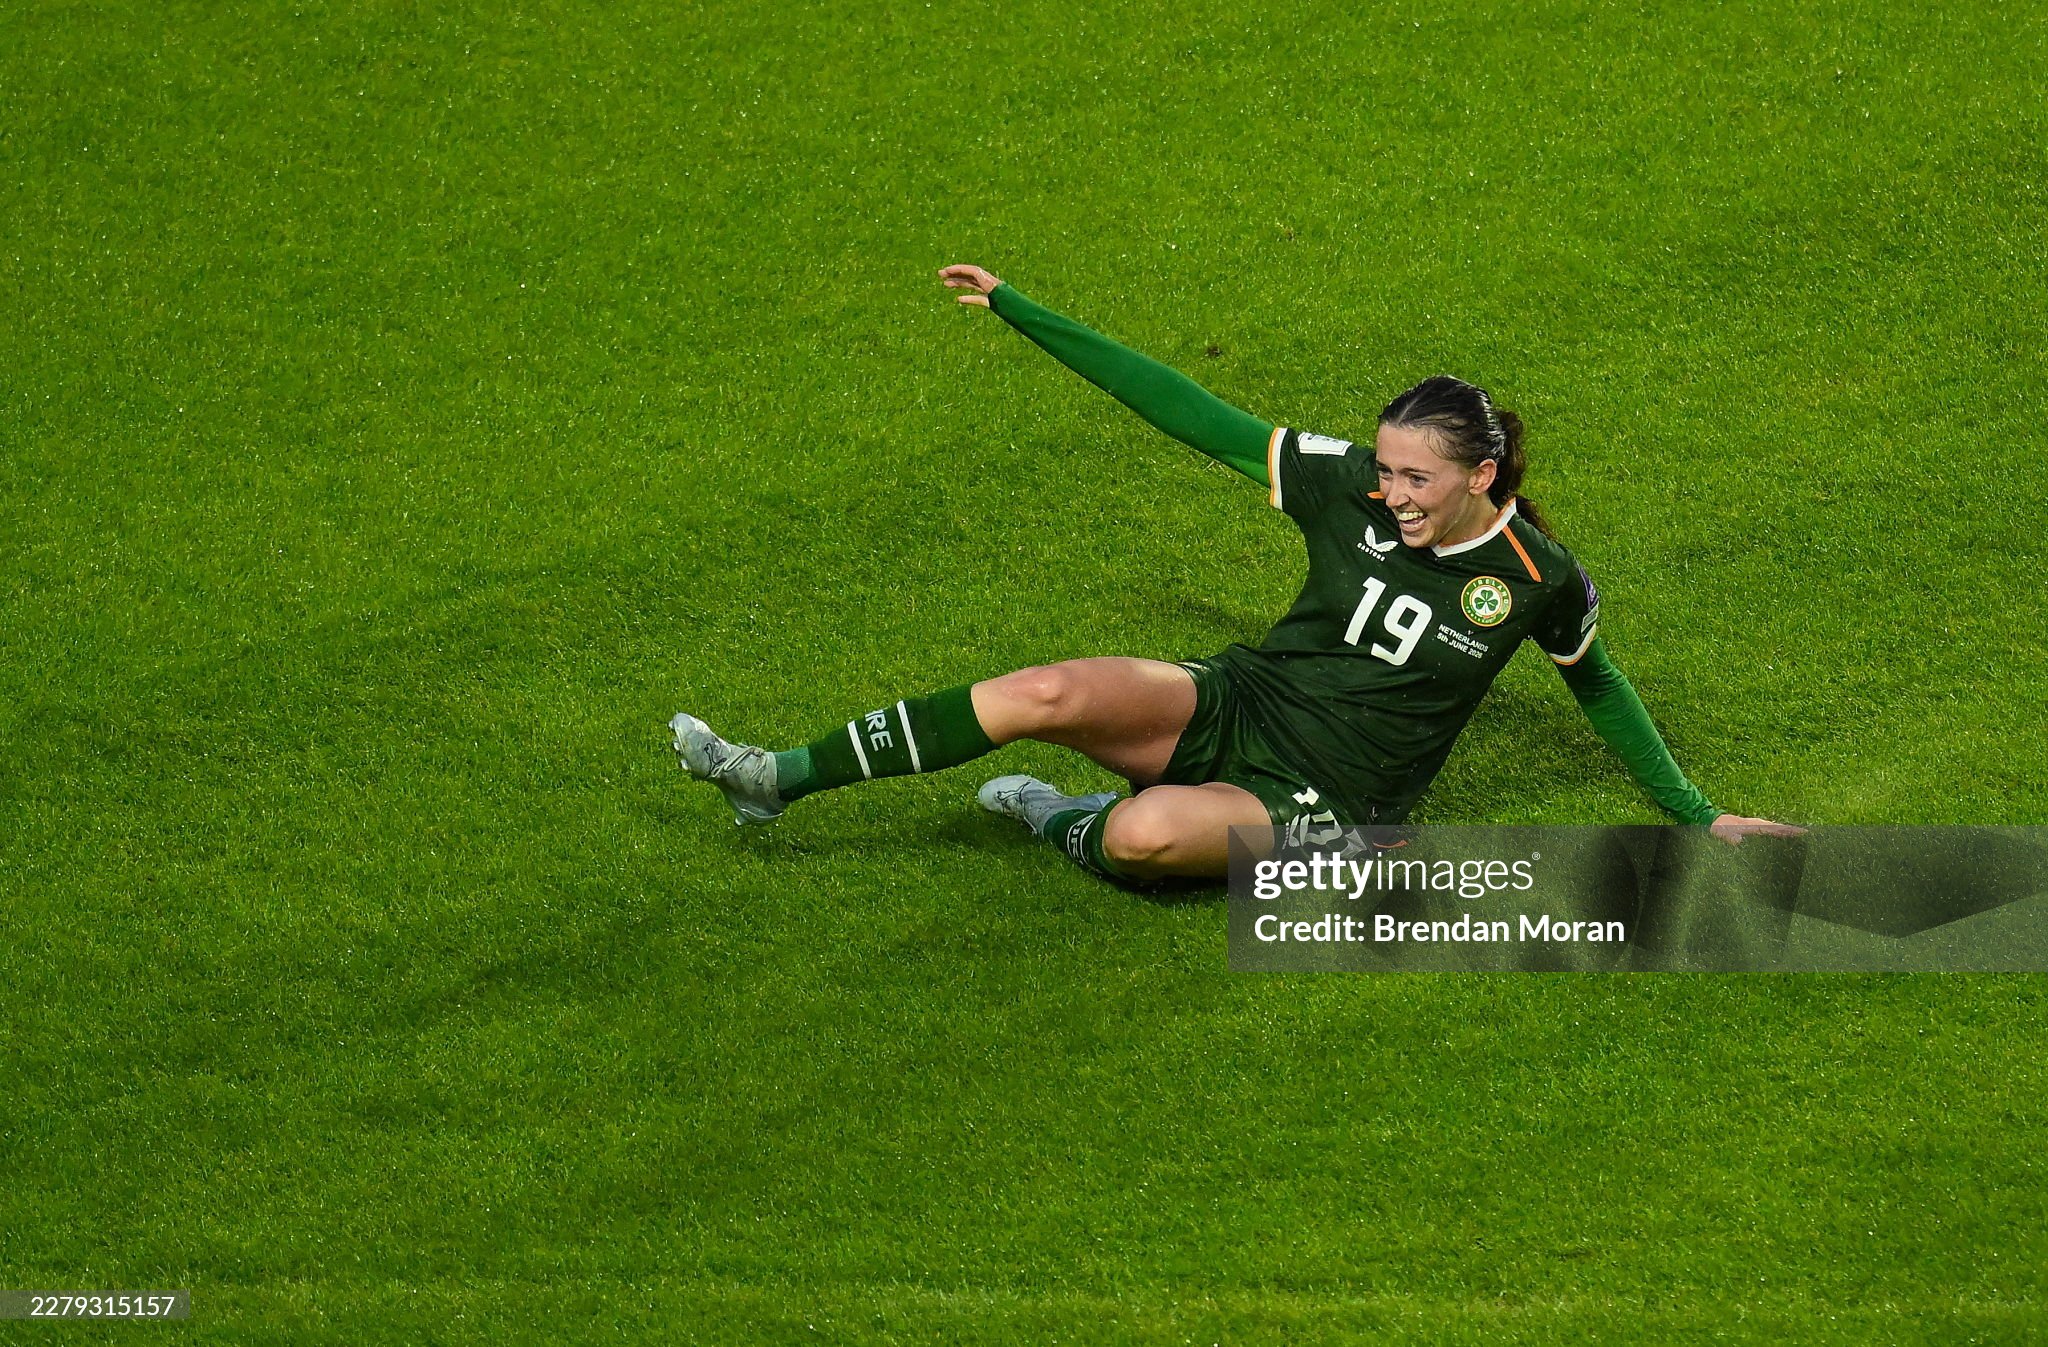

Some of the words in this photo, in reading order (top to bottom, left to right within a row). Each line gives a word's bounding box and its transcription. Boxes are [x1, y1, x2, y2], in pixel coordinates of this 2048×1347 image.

[1472, 579, 1509, 604] IRELAND
[1344, 576, 1433, 666] 19
[1436, 632, 1449, 643] 5th
[1448, 640, 1469, 653] JUNE
[1438, 624, 1489, 652] NETHERLANDS
